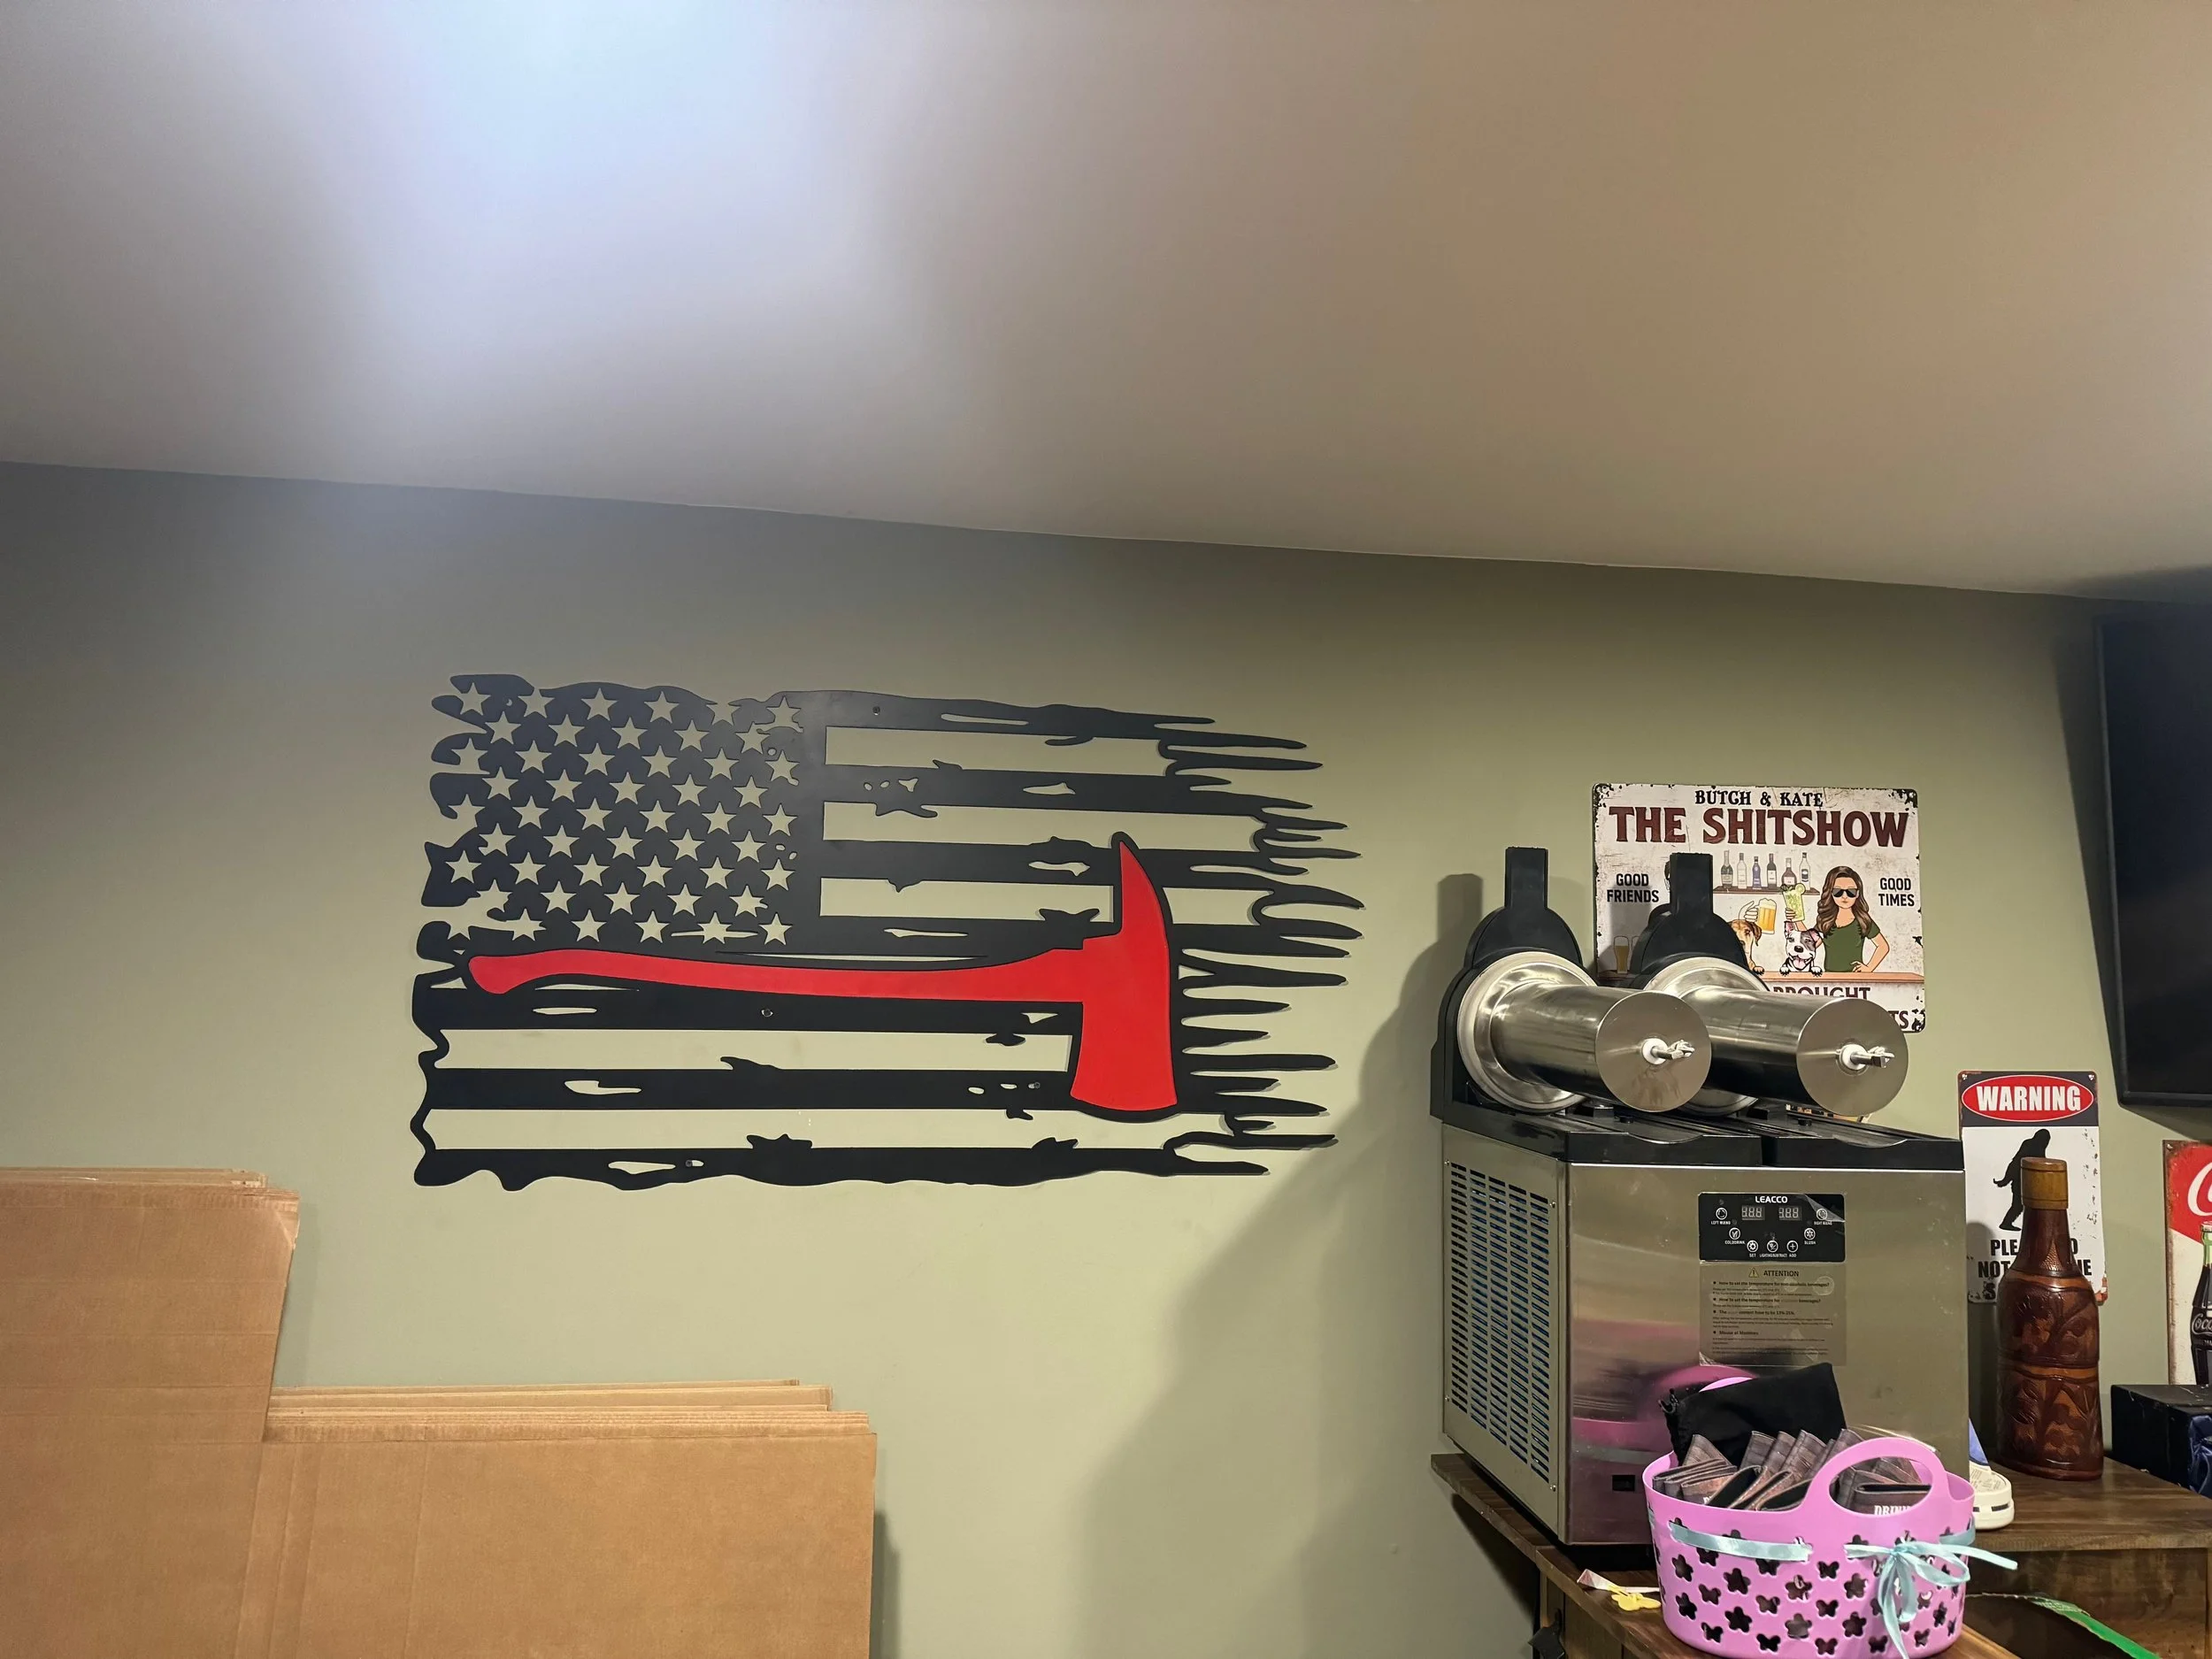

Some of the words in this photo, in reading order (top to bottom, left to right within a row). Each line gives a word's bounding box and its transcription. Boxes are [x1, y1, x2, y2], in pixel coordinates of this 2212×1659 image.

[1694, 789, 1752, 806] BUTCH
[1759, 792, 1772, 806] &
[1780, 792, 1824, 808] KATE
[1609, 806, 1686, 843] THE
[1702, 808, 1909, 848] SHITSHOW
[1616, 872, 1649, 887] GOOD
[1879, 877, 1912, 892] GOOD
[1607, 889, 1659, 903] FRIENDS
[1878, 893, 1915, 908] TIMES
[1976, 1086, 2081, 1112] WARNING
[1991, 1239, 2018, 1256] PLE
[1978, 1260, 2011, 1279] NOT
